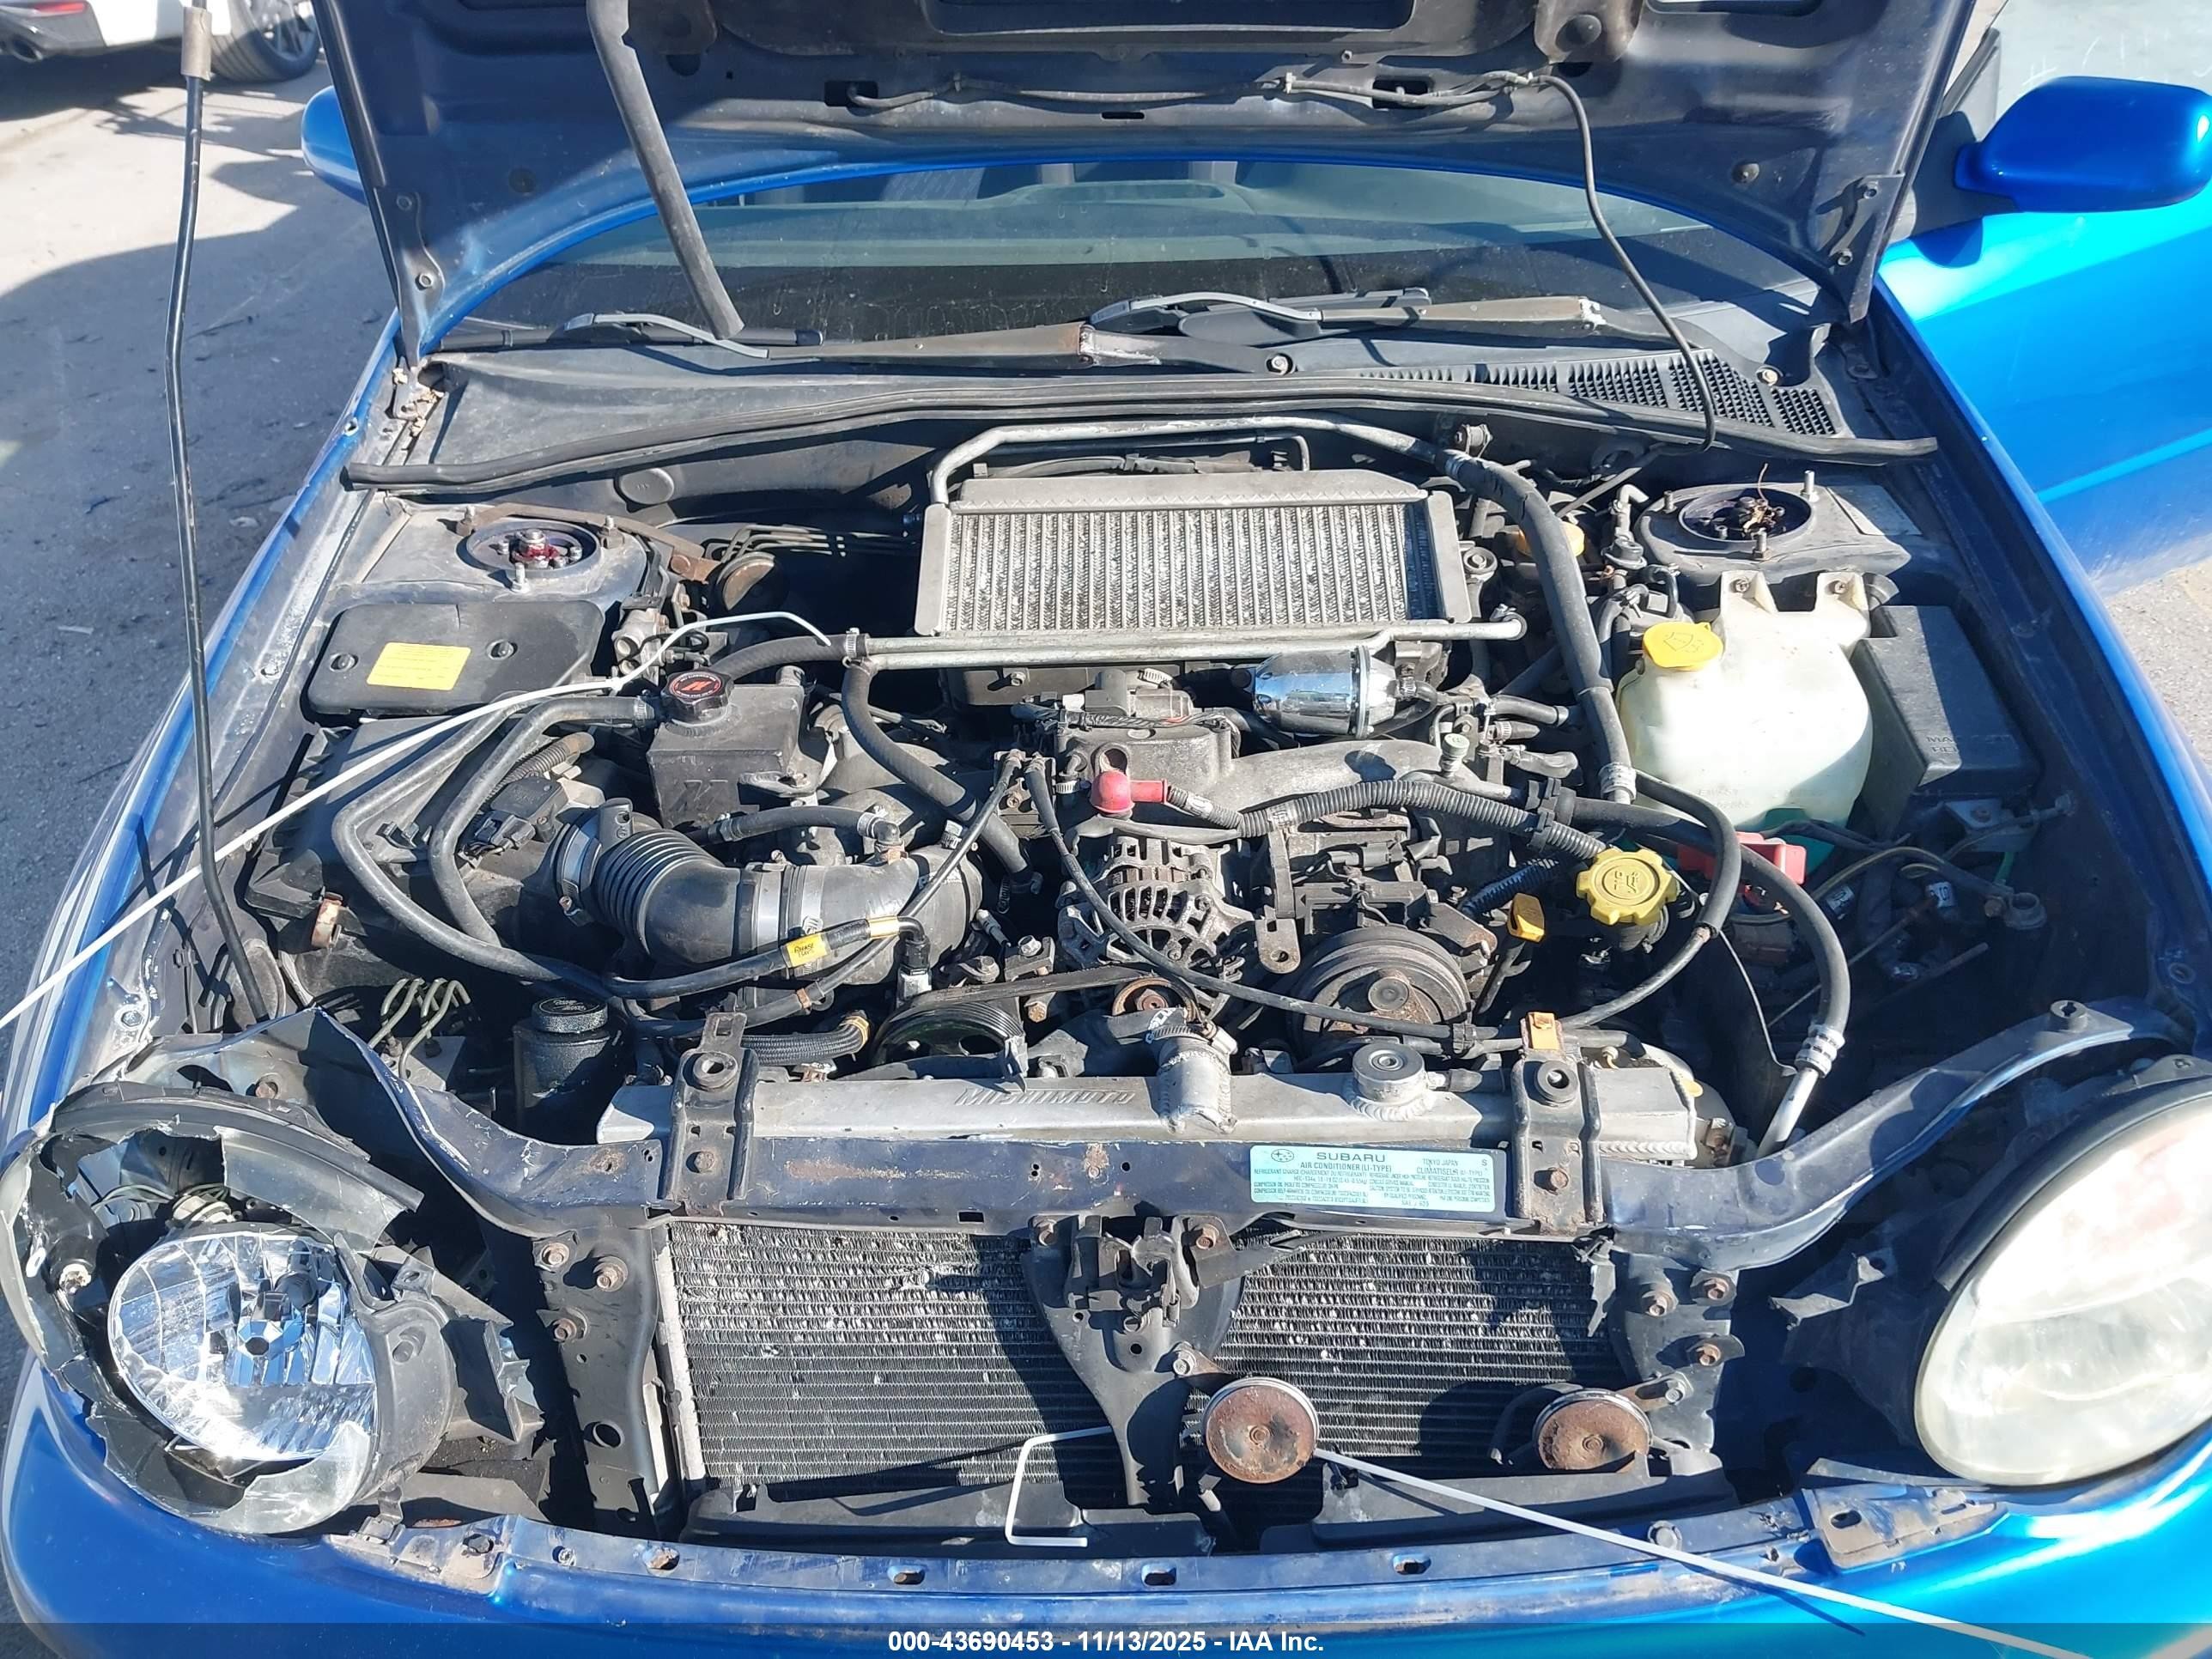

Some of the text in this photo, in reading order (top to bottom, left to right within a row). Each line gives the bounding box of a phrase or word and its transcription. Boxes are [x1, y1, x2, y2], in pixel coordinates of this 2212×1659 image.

[954, 1087, 1137, 1107] MISHIMOTO
[1316, 1152, 1386, 1163] SUBARU
[1441, 1158, 1459, 1167] JAPAN
[1314, 1162, 1360, 1171] CONDITIONER
